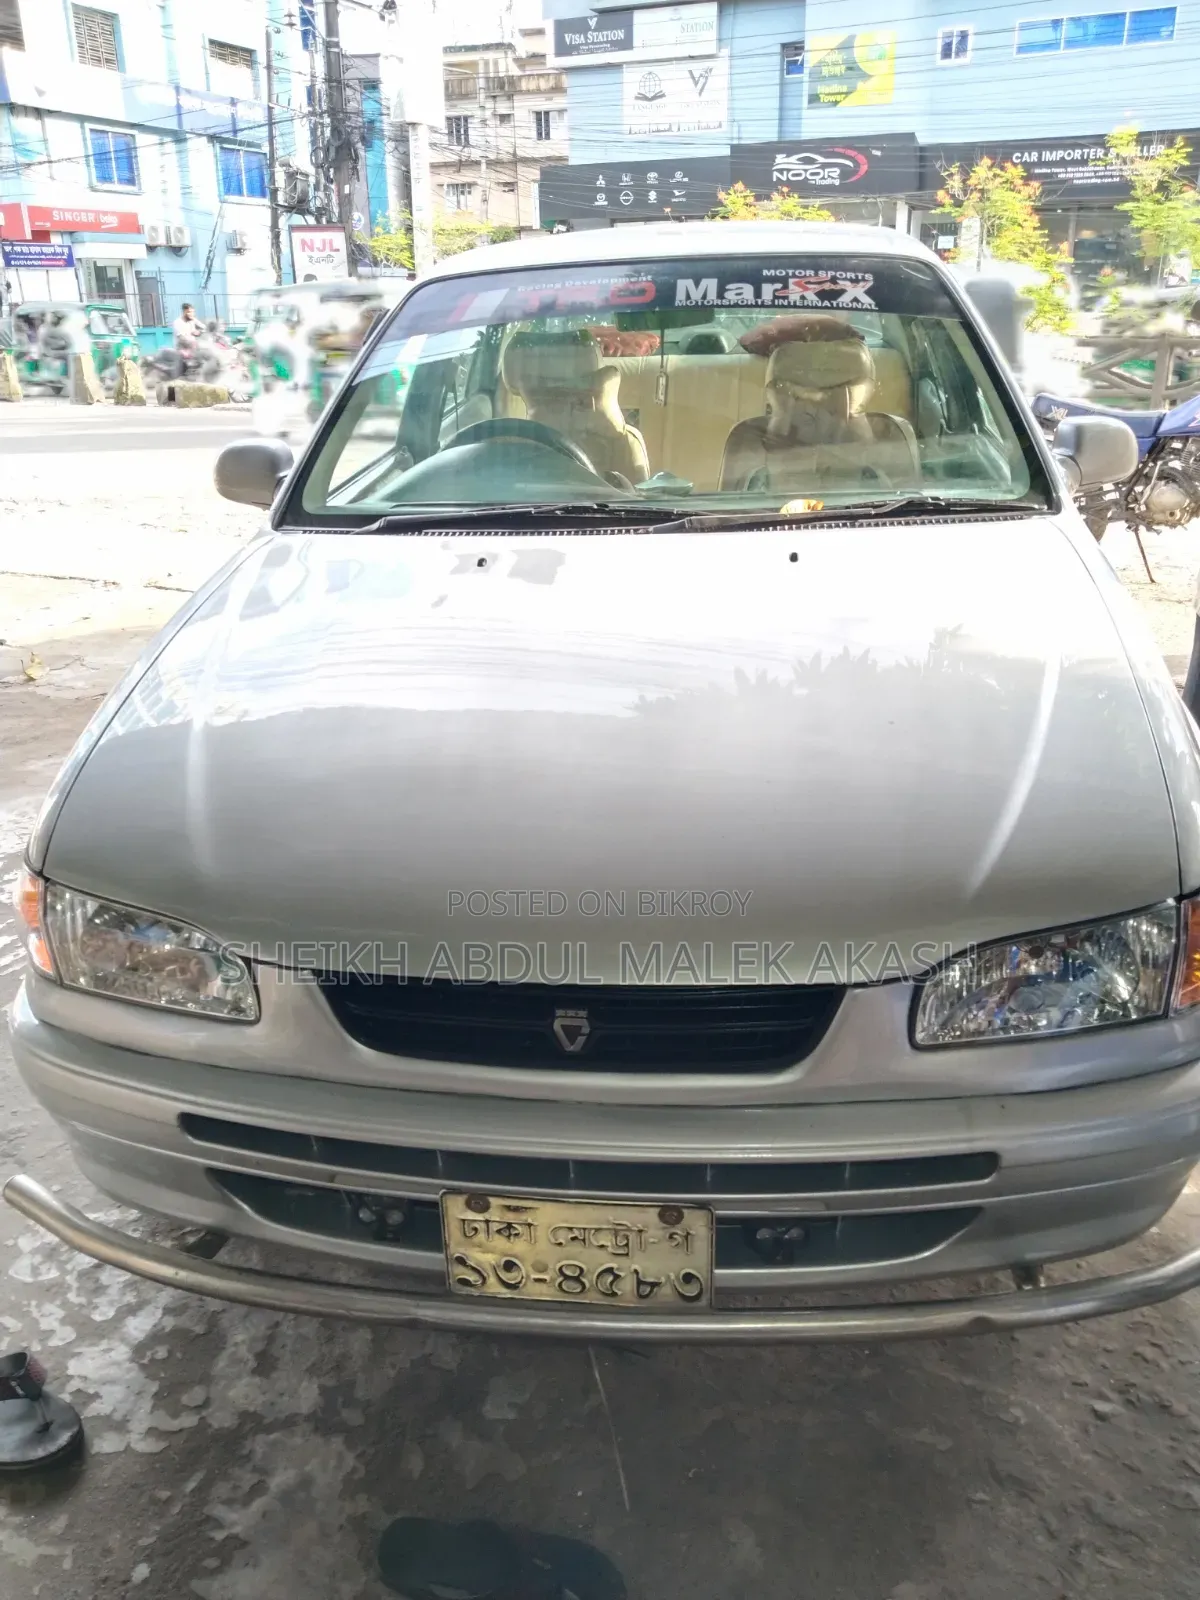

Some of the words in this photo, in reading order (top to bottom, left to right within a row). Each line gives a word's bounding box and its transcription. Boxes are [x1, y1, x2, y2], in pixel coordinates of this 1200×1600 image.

[564, 33, 585, 45] VISA
[587, 29, 625, 43] STATION
[1012, 151, 1038, 164] CAR
[1041, 147, 1105, 162] IMPORTER
[772, 167, 841, 182] NOOR
[52, 210, 96, 223] SINGER
[300, 238, 340, 252] NJL
[762, 269, 814, 278] MOTOR
[818, 270, 873, 280] SPORTS
[518, 281, 561, 292] Racing
[675, 278, 821, 301] Mark
[674, 298, 772, 307] MOTORSPORTS
[774, 298, 879, 310] INTERNATIONAL
[457, 1214, 538, 1244] ঢাকা
